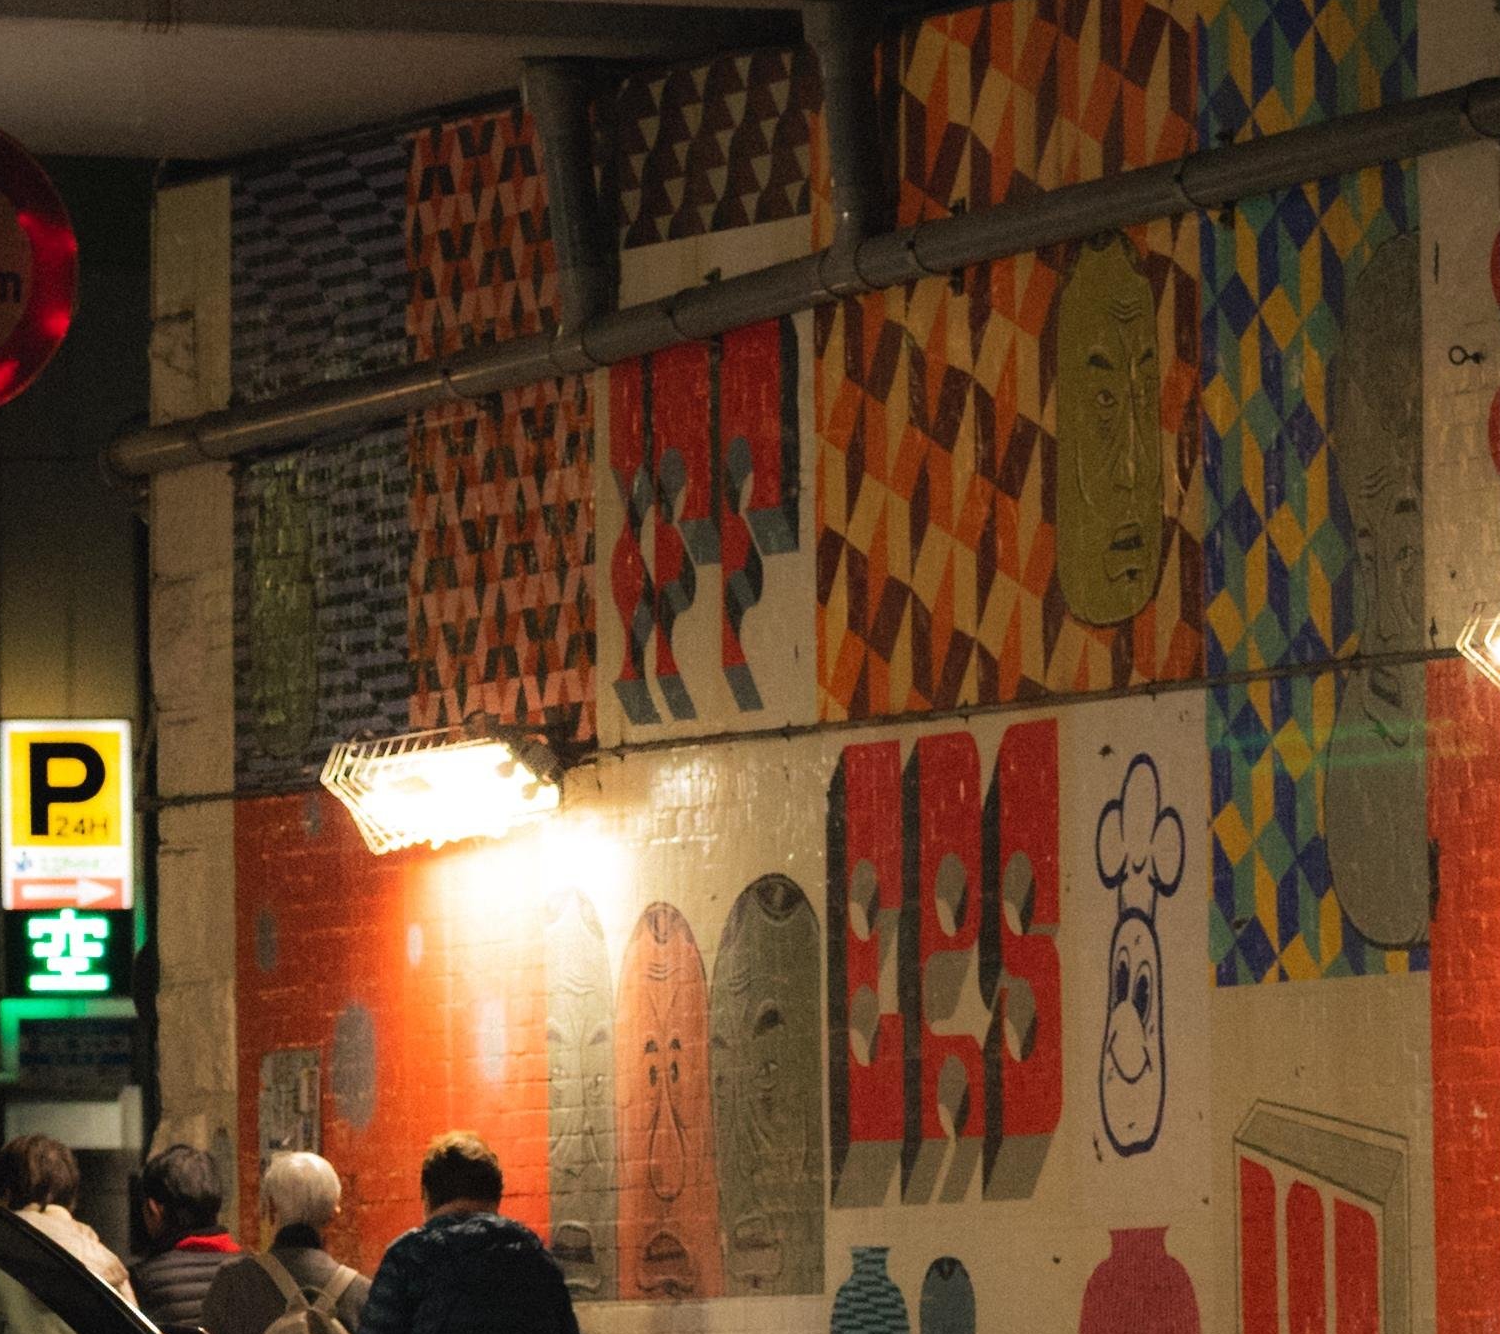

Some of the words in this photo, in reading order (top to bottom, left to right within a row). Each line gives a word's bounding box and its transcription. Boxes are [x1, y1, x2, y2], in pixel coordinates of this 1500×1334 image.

[29, 741, 106, 836] P
[55, 815, 110, 837] 24H
[27, 907, 111, 992] 空
